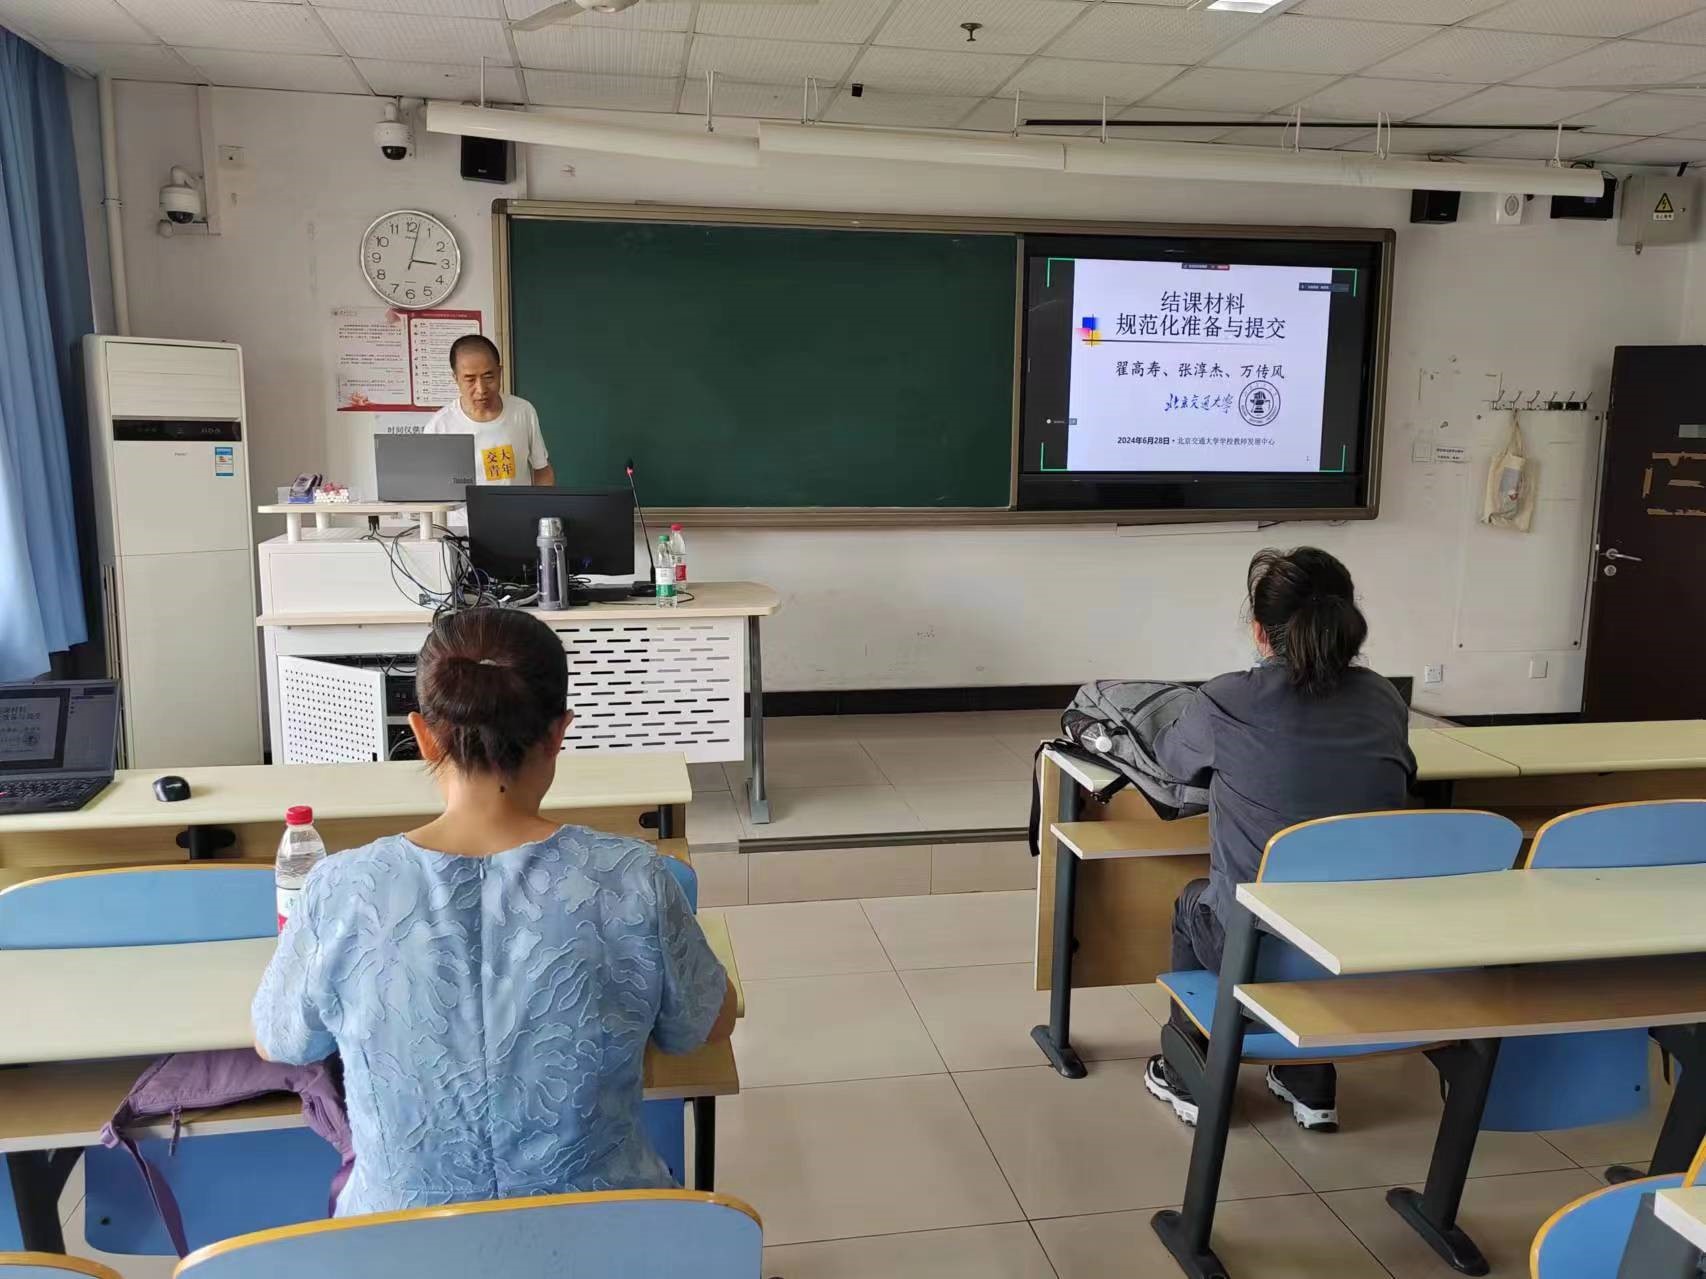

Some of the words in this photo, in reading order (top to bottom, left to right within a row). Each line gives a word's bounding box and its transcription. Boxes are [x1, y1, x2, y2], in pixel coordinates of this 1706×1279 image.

[390, 223, 399, 235] 11
[406, 221, 418, 233] 12
[427, 227, 431, 239] 1
[375, 236, 390, 248] 10
[436, 241, 446, 253] 2
[371, 252, 382, 264] 9
[440, 259, 450, 270] 3
[376, 269, 386, 281] 8
[435, 275, 444, 286] 4
[391, 283, 400, 294] 7
[405, 289, 416, 300] 6
[423, 286, 433, 297] 5
[1160, 290, 1245, 315] 结课材料
[1116, 312, 1286, 339] 规范化准备与提交
[1164, 392, 1234, 414] 北京交通大学
[1117, 437, 1170, 445] 2024年6月28日
